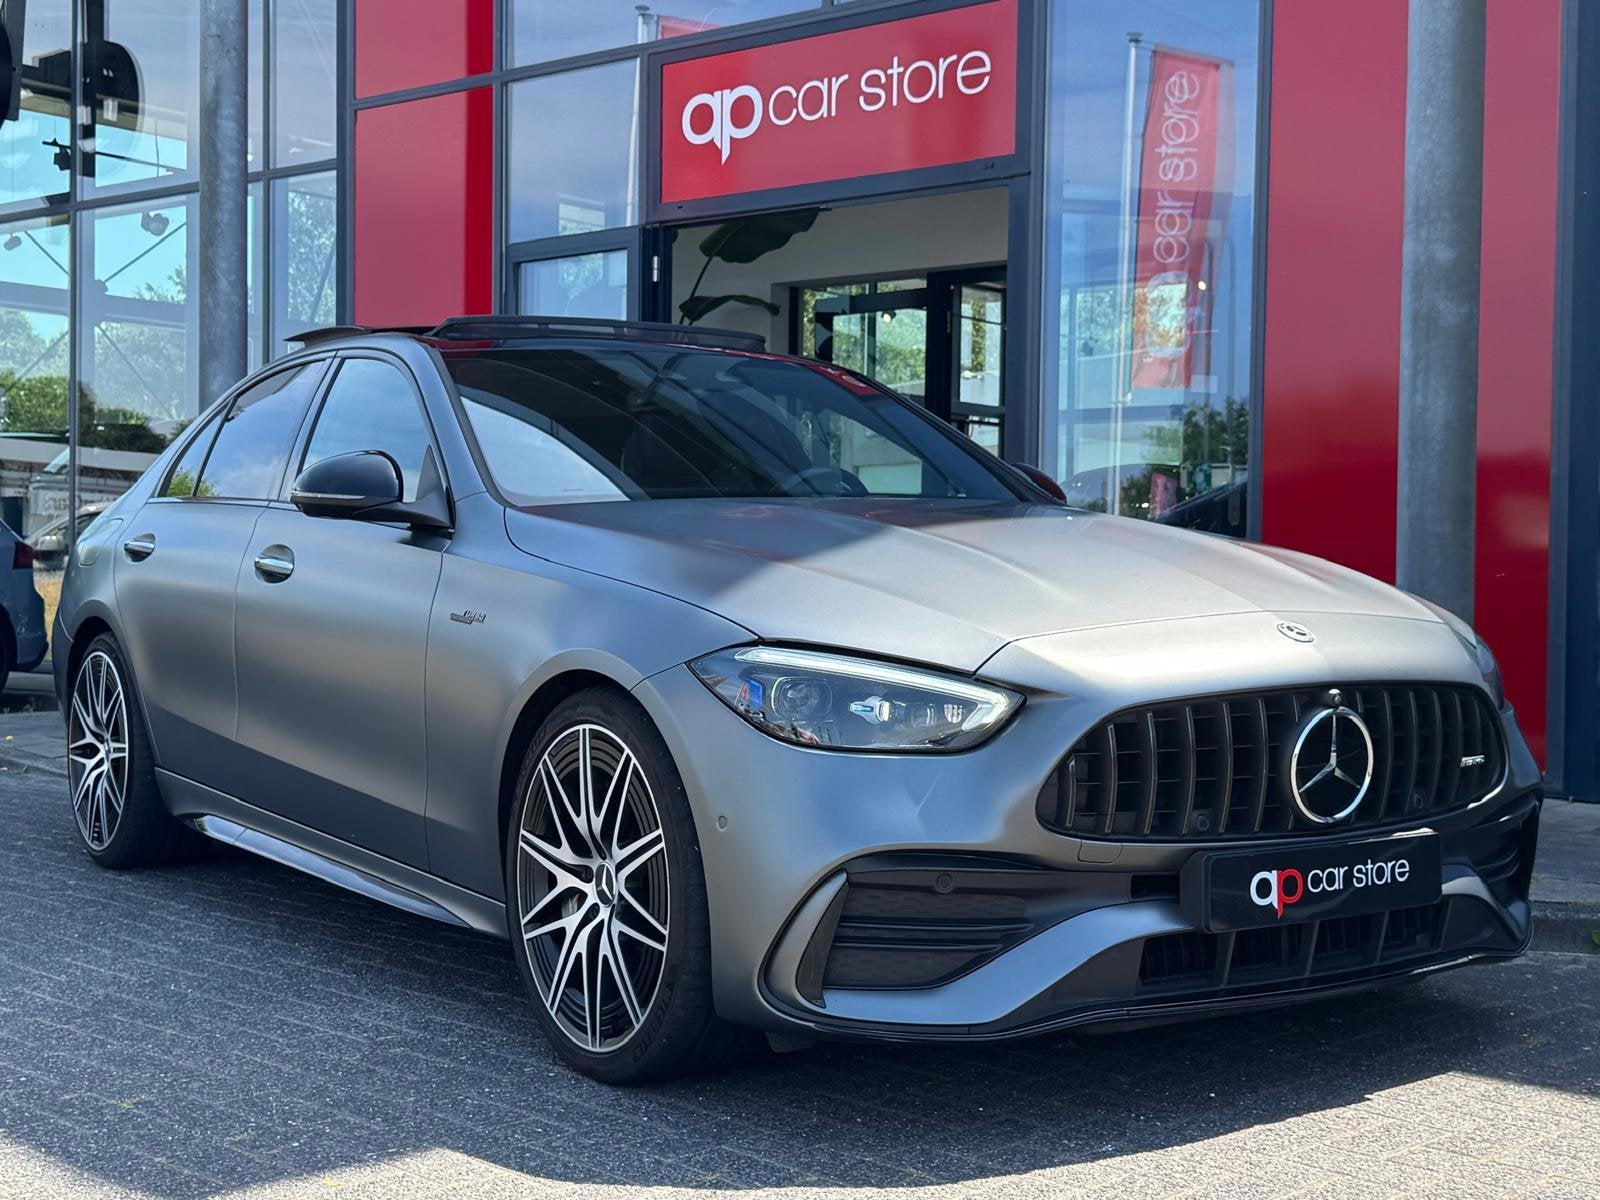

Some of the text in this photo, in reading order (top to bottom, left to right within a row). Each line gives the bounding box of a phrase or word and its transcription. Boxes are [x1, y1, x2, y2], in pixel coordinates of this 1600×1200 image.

[682, 50, 992, 166] ap car store
[1154, 70, 1200, 183] store
[1153, 190, 1195, 264] car
[1250, 859, 1410, 920] ap car store
